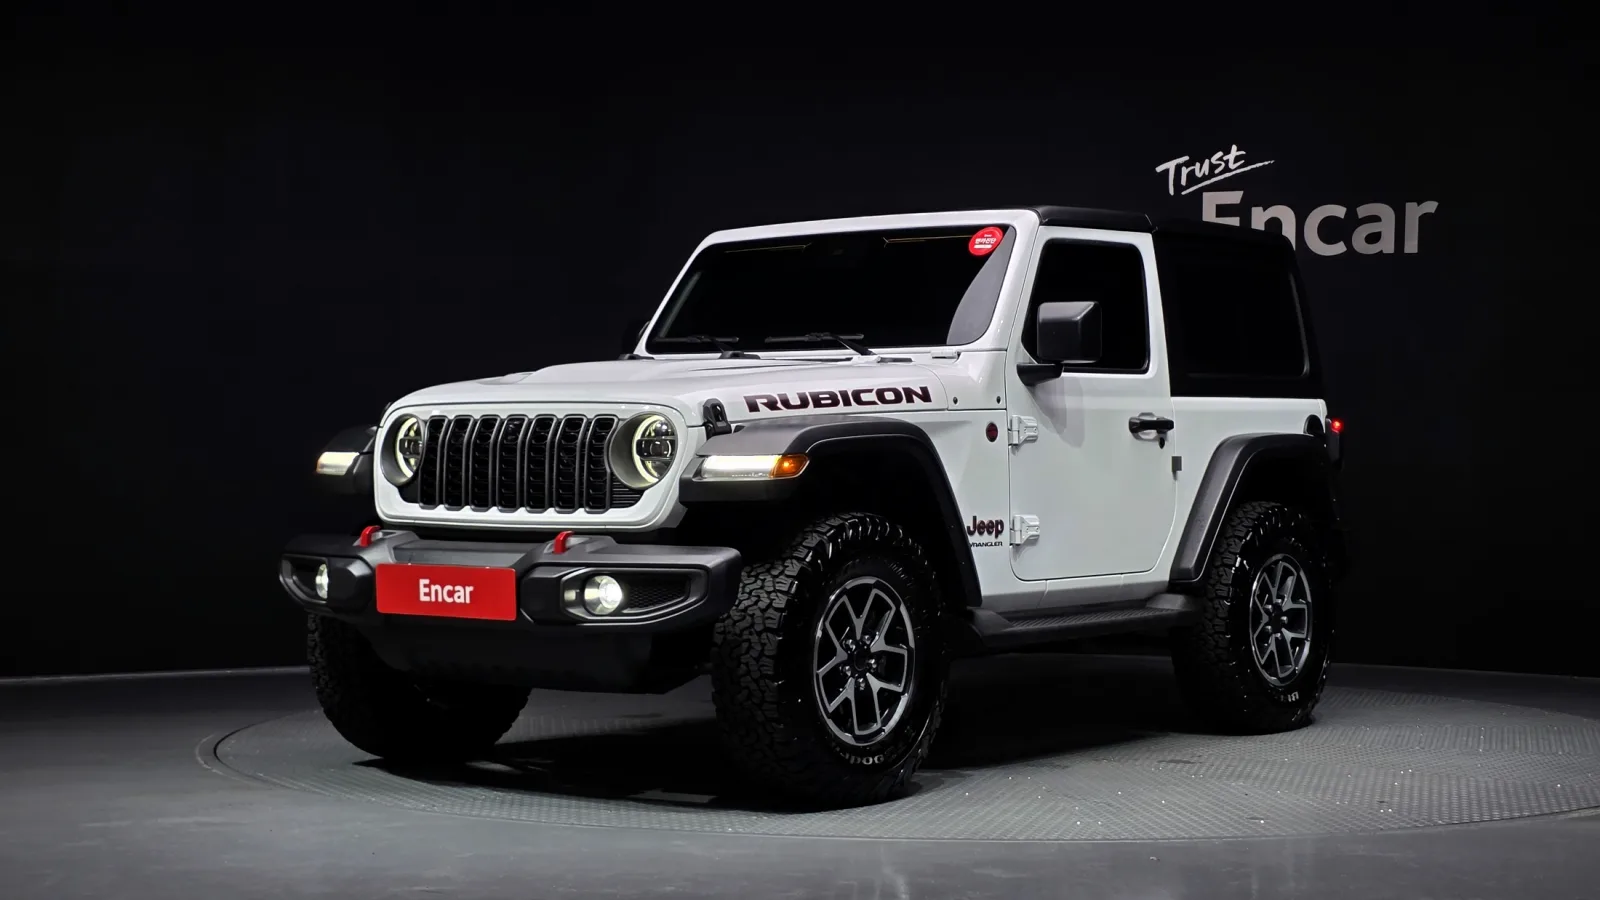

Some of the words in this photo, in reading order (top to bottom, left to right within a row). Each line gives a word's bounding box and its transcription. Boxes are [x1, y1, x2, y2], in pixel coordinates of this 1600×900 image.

[1156, 145, 1246, 195] Trust
[743, 386, 932, 413] RUBICON
[967, 515, 1004, 539] Jeep
[419, 578, 474, 604] Encar
